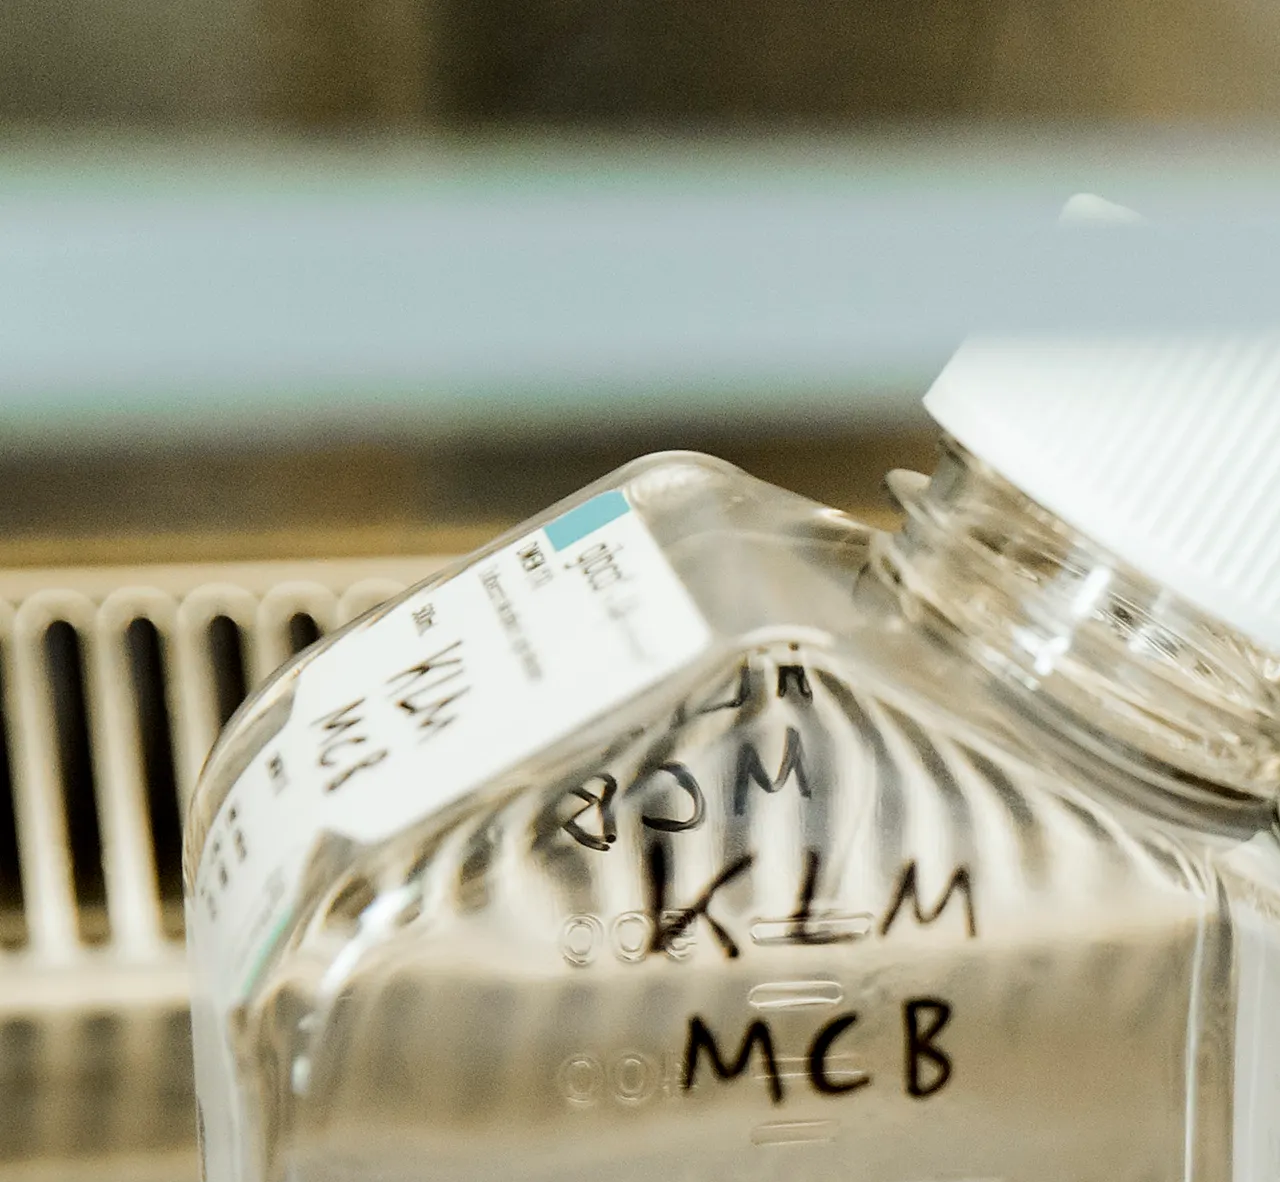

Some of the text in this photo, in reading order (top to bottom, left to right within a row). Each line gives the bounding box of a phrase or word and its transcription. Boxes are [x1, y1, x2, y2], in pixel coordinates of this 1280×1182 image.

[386, 638, 473, 744] KLM
[645, 848, 980, 960] KLM
[679, 996, 955, 1106] MCB
